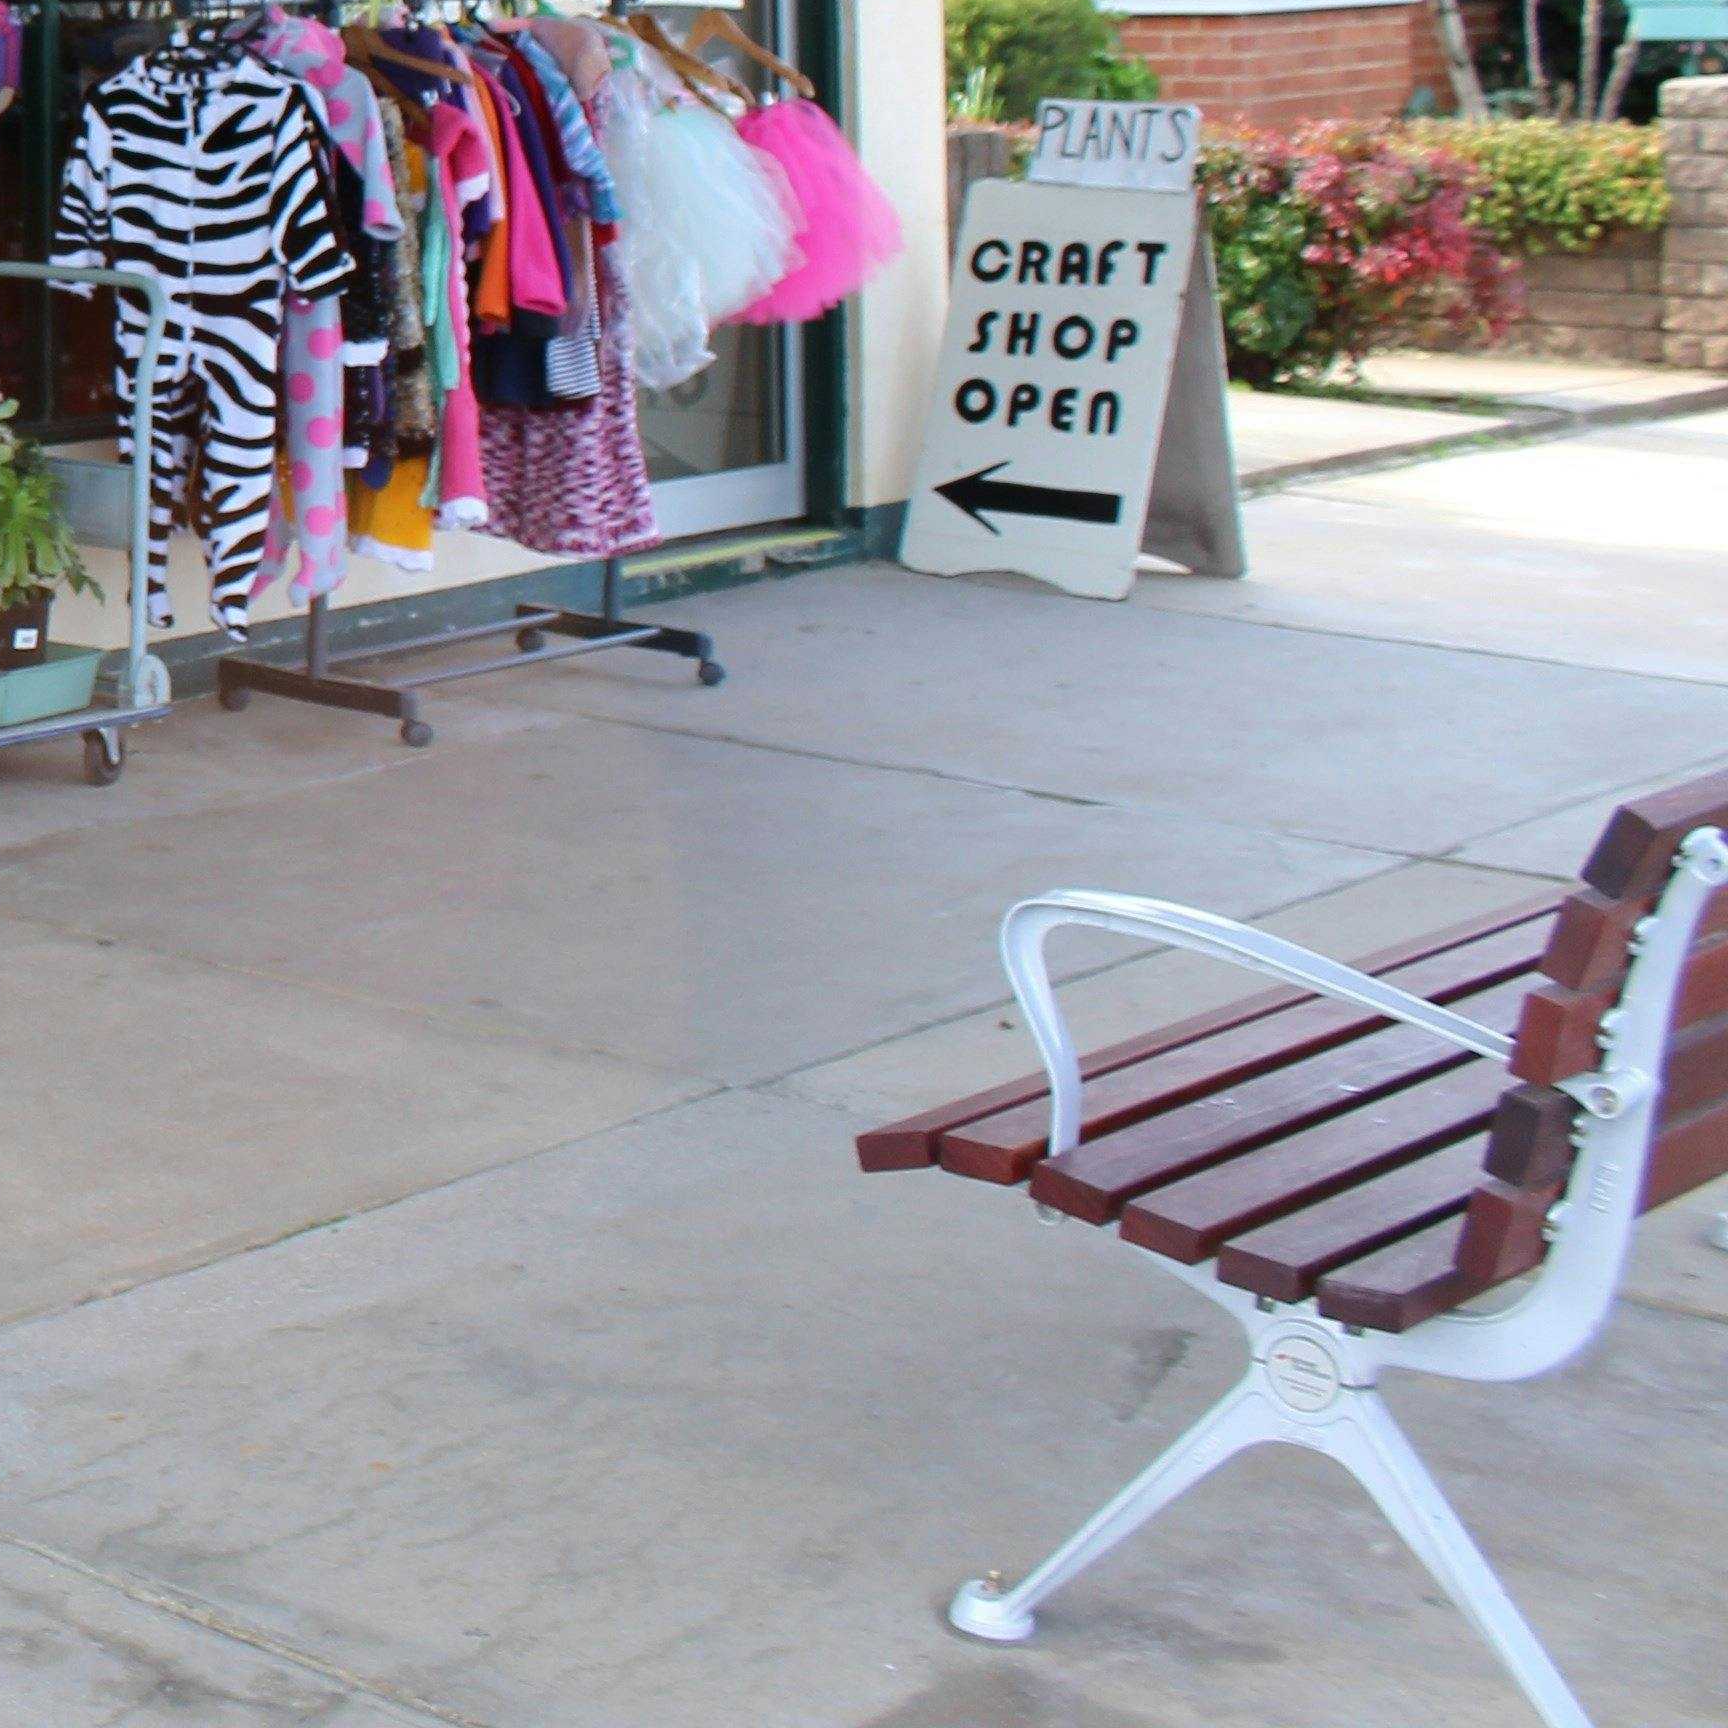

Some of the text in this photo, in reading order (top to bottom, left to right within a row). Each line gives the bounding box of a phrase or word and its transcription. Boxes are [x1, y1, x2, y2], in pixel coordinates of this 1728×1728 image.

[1041, 105, 1194, 163] PLANTS
[970, 238, 1171, 286] CRAFT
[966, 310, 1141, 363] SHOP
[954, 377, 1121, 435] OPEN
